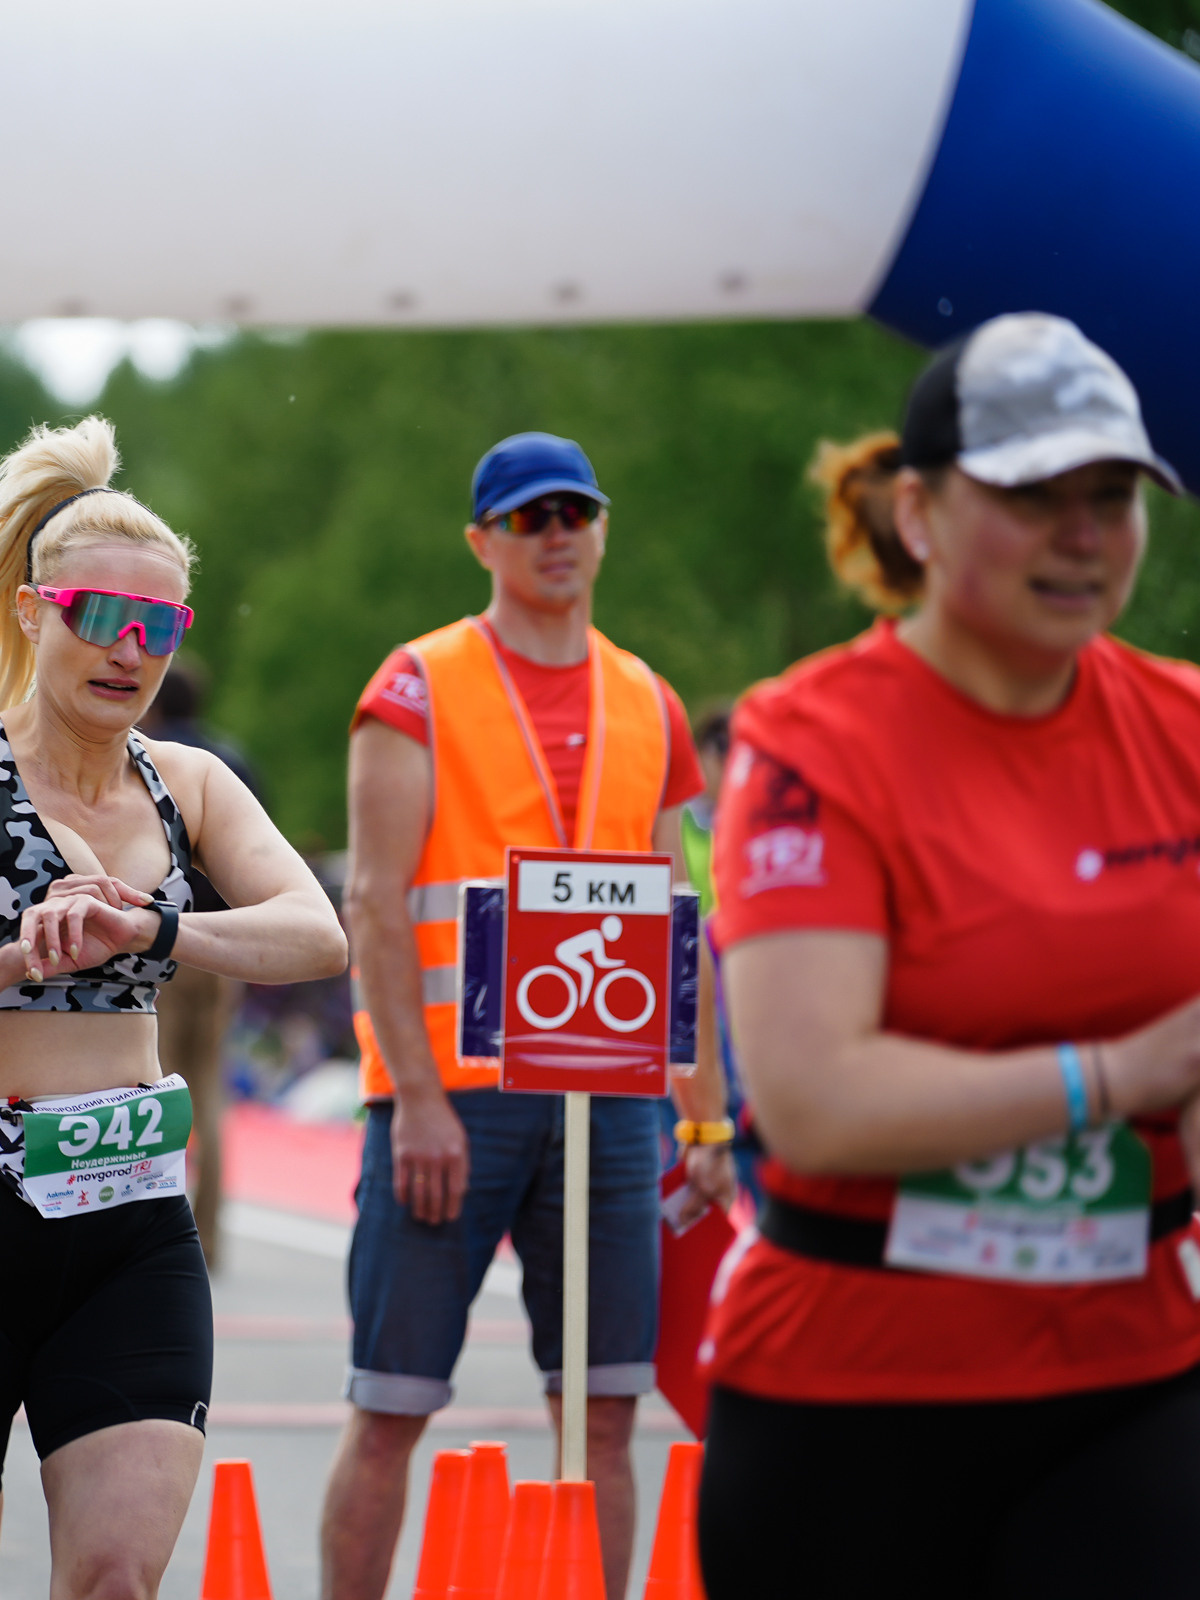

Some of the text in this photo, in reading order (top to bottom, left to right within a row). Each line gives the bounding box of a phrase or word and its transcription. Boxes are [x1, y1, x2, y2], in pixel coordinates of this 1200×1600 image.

[552, 872, 573, 903] 5
[58, 1097, 163, 1157] Э42
[70, 1151, 147, 1169] Неудержимые
